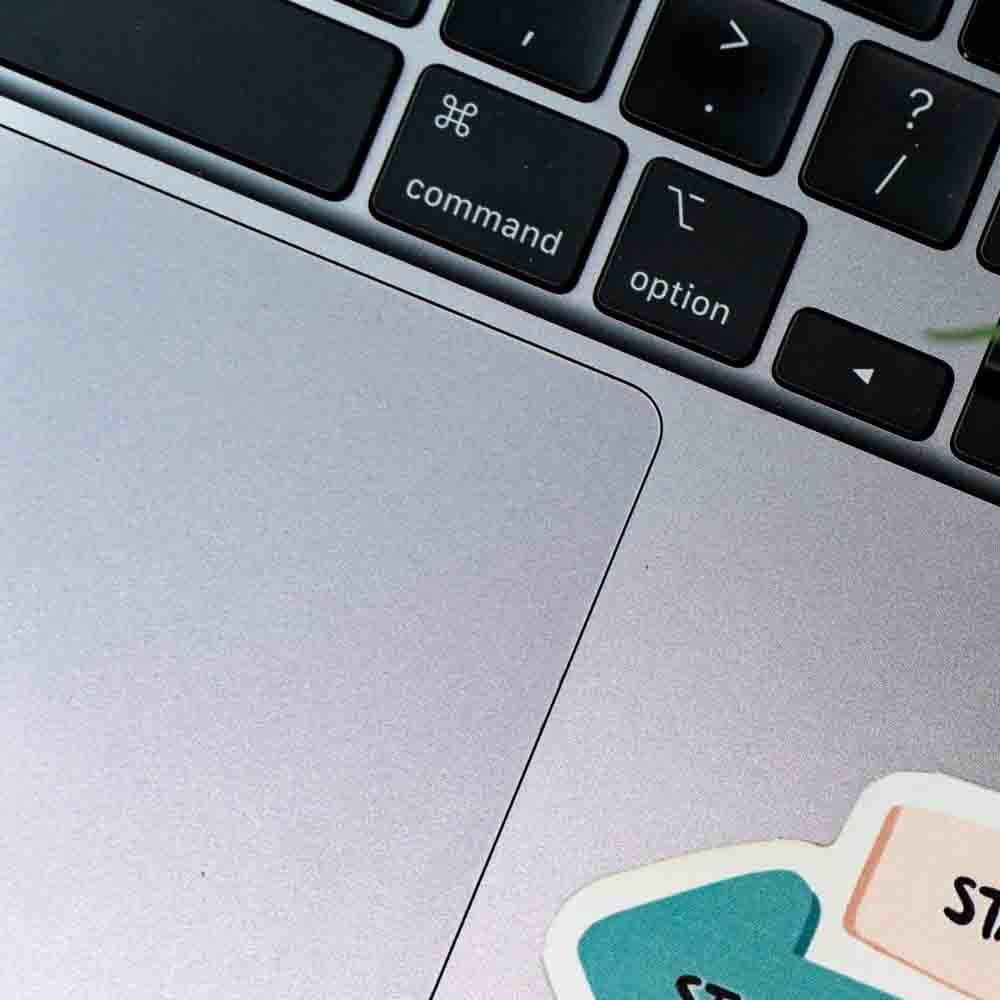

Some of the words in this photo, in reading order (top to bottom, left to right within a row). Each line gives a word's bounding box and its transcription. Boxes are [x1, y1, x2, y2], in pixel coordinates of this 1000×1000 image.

[719, 19, 750, 50] >
[905, 87, 934, 129] ?
[874, 154, 907, 194] /
[405, 178, 563, 257] command
[629, 270, 731, 326] option
